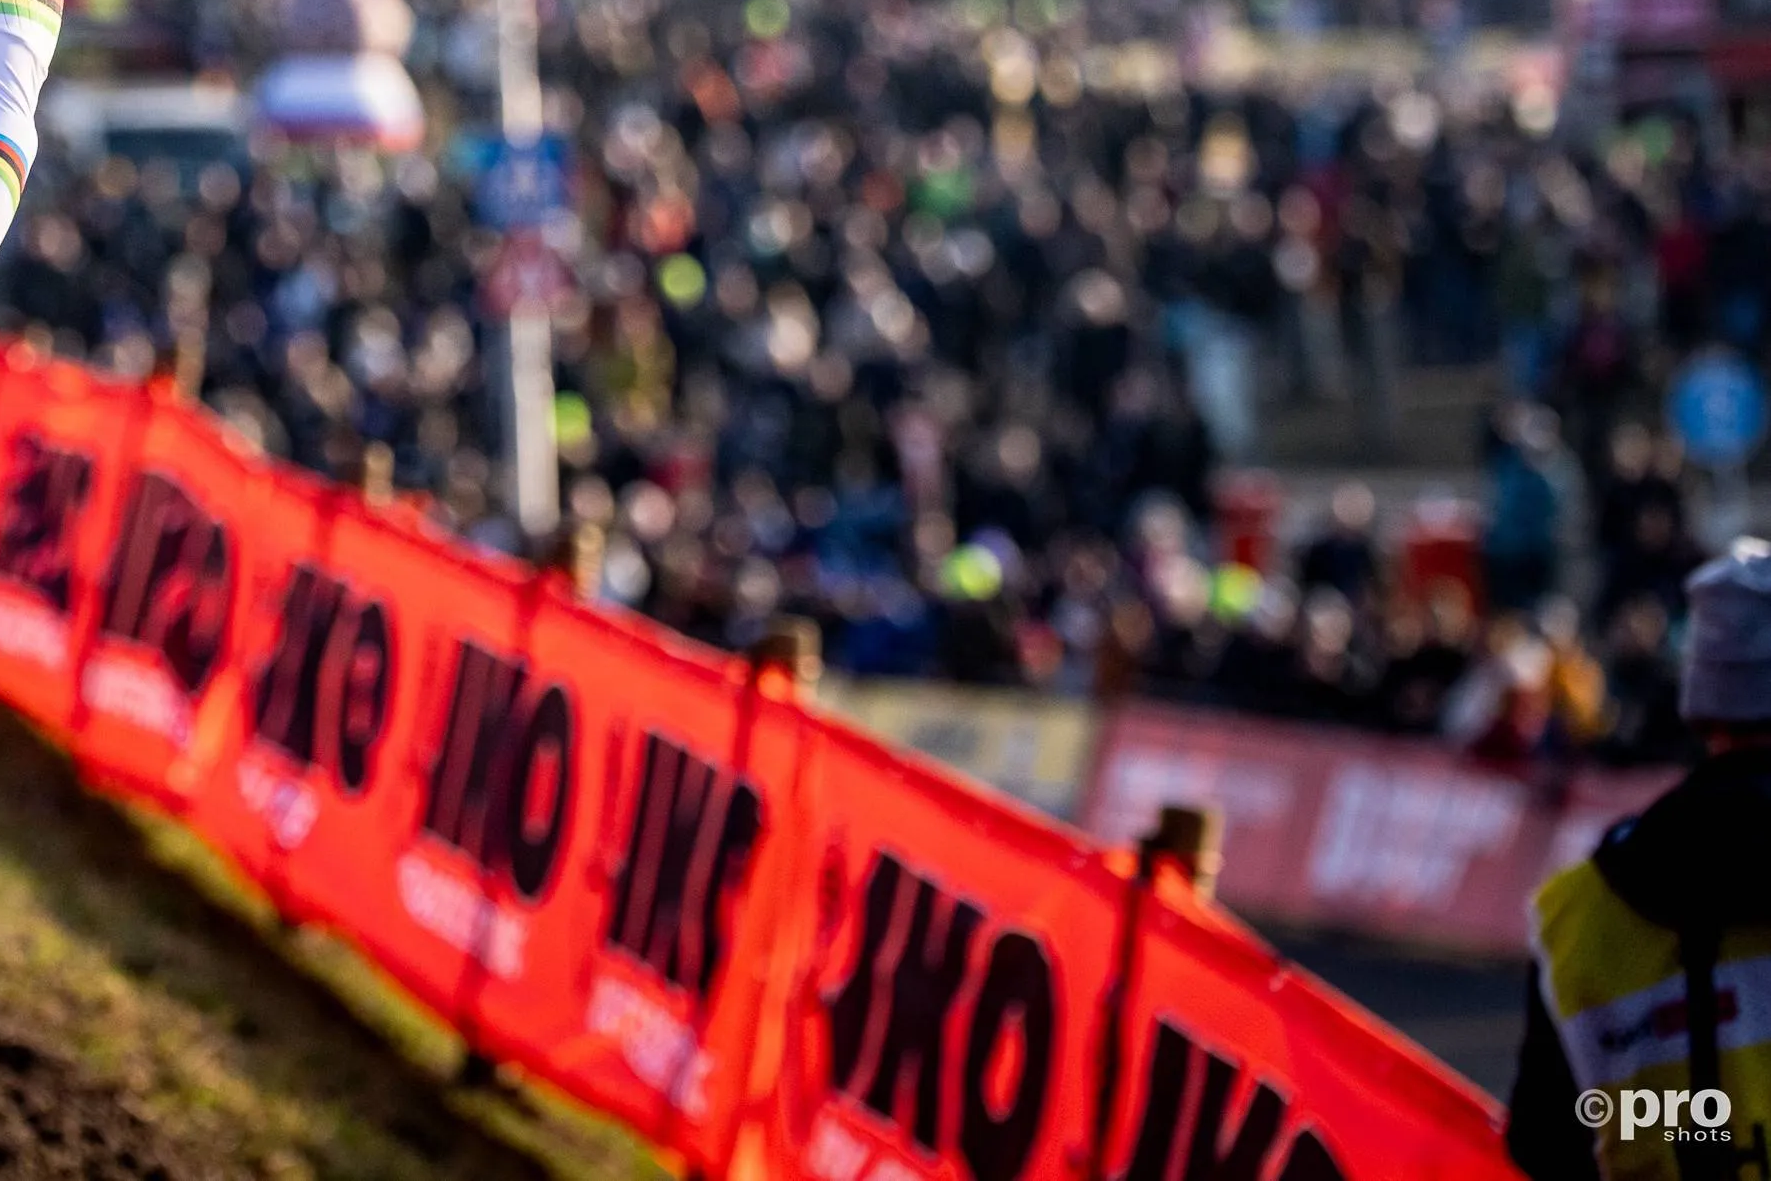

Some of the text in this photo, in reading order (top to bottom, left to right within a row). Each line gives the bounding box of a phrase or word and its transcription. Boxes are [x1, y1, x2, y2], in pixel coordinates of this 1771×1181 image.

[606, 729, 764, 1001] IK
[825, 849, 1060, 1181] IKO
[1118, 1014, 1350, 1181] IK
